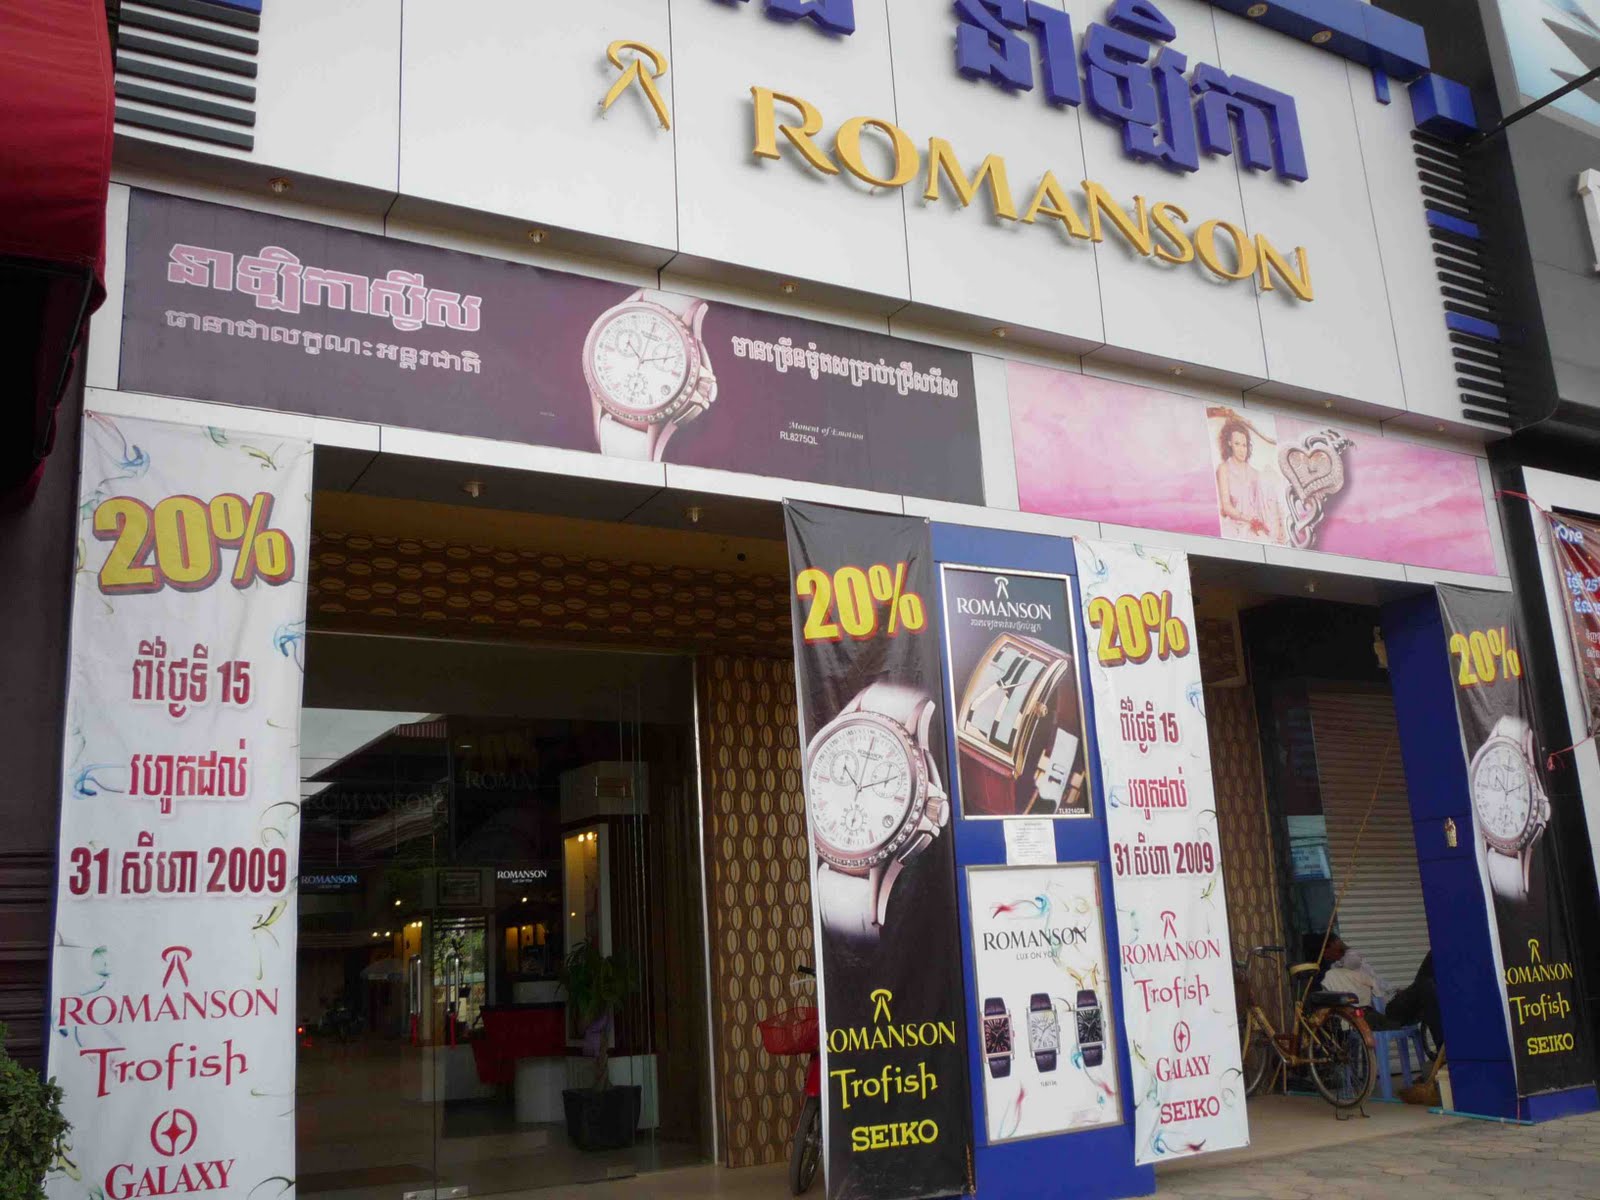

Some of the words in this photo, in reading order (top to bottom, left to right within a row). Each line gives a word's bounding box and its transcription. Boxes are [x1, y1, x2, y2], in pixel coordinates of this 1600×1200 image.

[751, 86, 1313, 302] ROMANSON
[93, 492, 295, 595] 20%
[796, 562, 926, 643] 20%
[957, 597, 1052, 620] ROMANSON
[1088, 590, 1189, 668] 20%
[1450, 626, 1522, 687] 20%
[217, 661, 250, 704] 15
[1159, 711, 1180, 743] 15
[69, 847, 109, 895] 31
[207, 847, 287, 893] 2009
[497, 869, 548, 880] ROMANSON
[1113, 843, 1130, 876] 31
[1174, 842, 1215, 874] 2009
[301, 874, 358, 884] ROMANSON
[983, 926, 1087, 950] ROMANSON
[1016, 952, 1028, 960] LUX
[1030, 952, 1042, 960] ON
[1044, 950, 1057, 958] YOU
[1122, 939, 1221, 965] ROMANSON
[58, 987, 279, 1026] ROMANSON
[1134, 974, 1211, 1013] Trofish
[1509, 992, 1570, 1025] Trofish
[1527, 1032, 1574, 1055] SEIKO
[80, 1039, 248, 1099] Trofish
[830, 1062, 938, 1109] Trofish
[1156, 1055, 1211, 1082] GALAXY
[1160, 1095, 1220, 1124] SEIKO
[852, 1119, 938, 1151] SEIKO
[105, 1158, 235, 1200] GALAXY
